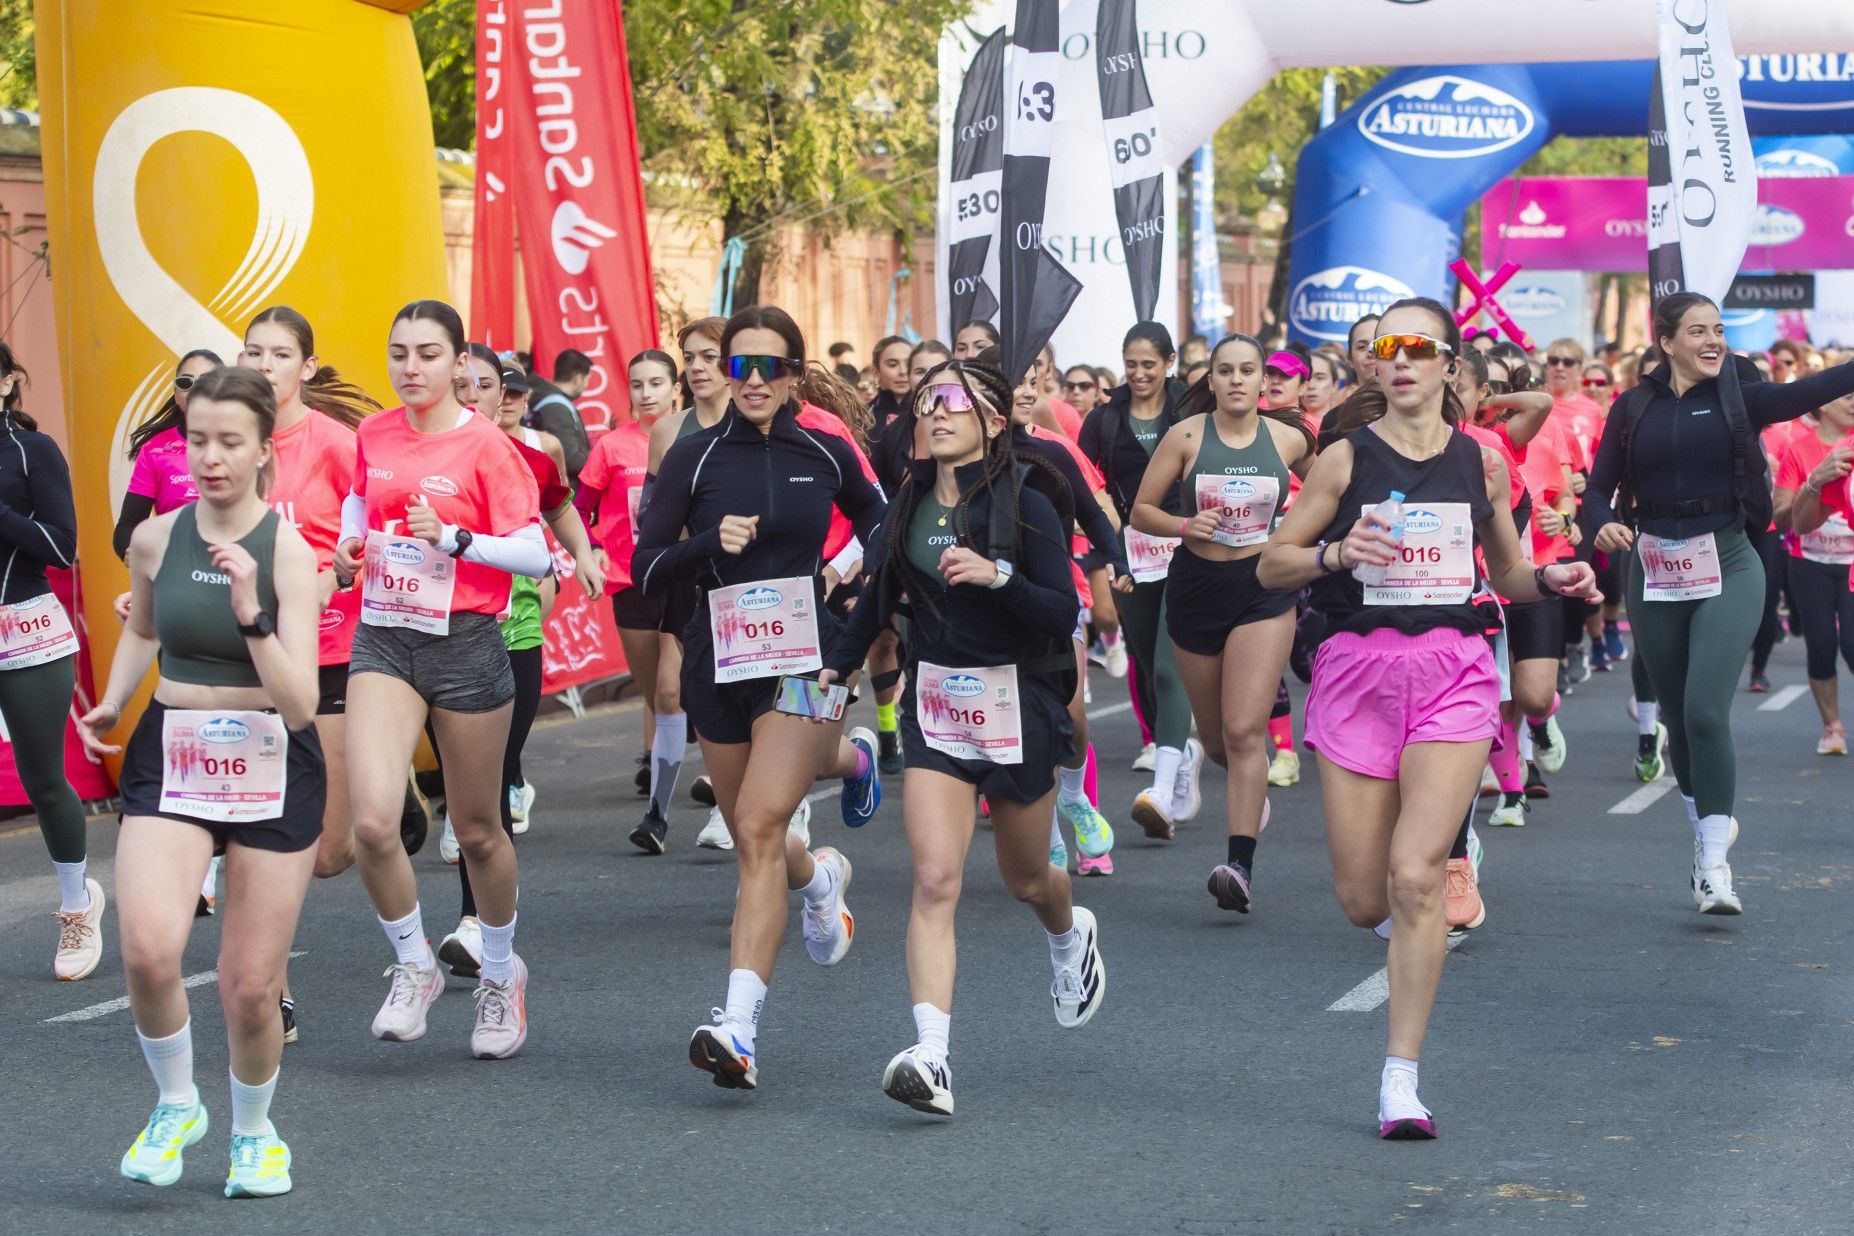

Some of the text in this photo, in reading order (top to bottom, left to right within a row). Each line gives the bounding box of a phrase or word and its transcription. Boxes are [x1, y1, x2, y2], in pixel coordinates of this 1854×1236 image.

[1369, 103, 1519, 139] ASTURIANA
[1704, 86, 1736, 184] RUNNING
[1736, 284, 1804, 302] OYSHO
[1225, 466, 1259, 475] OYSHO
[1223, 506, 1251, 518] 016
[928, 535, 957, 545] OYSH
[387, 550, 421, 561] ASTURIANA
[1151, 543, 1174, 556] 016
[1402, 547, 1441, 563] 016
[1664, 558, 1692, 572] 016
[384, 575, 420, 592] 016
[741, 596, 779, 607] ASTURIANA
[1376, 591, 1411, 600] OYSHO
[20, 614, 51, 634] 016
[745, 620, 784, 639] 016
[727, 665, 759, 677] OYSHO
[944, 682, 982, 692] ASTURIANA
[949, 708, 986, 725] 016
[202, 728, 247, 737] ASTURIANA
[205, 758, 247, 775] 016
[222, 784, 231, 792] 43
[175, 801, 214, 814] OYSHO
